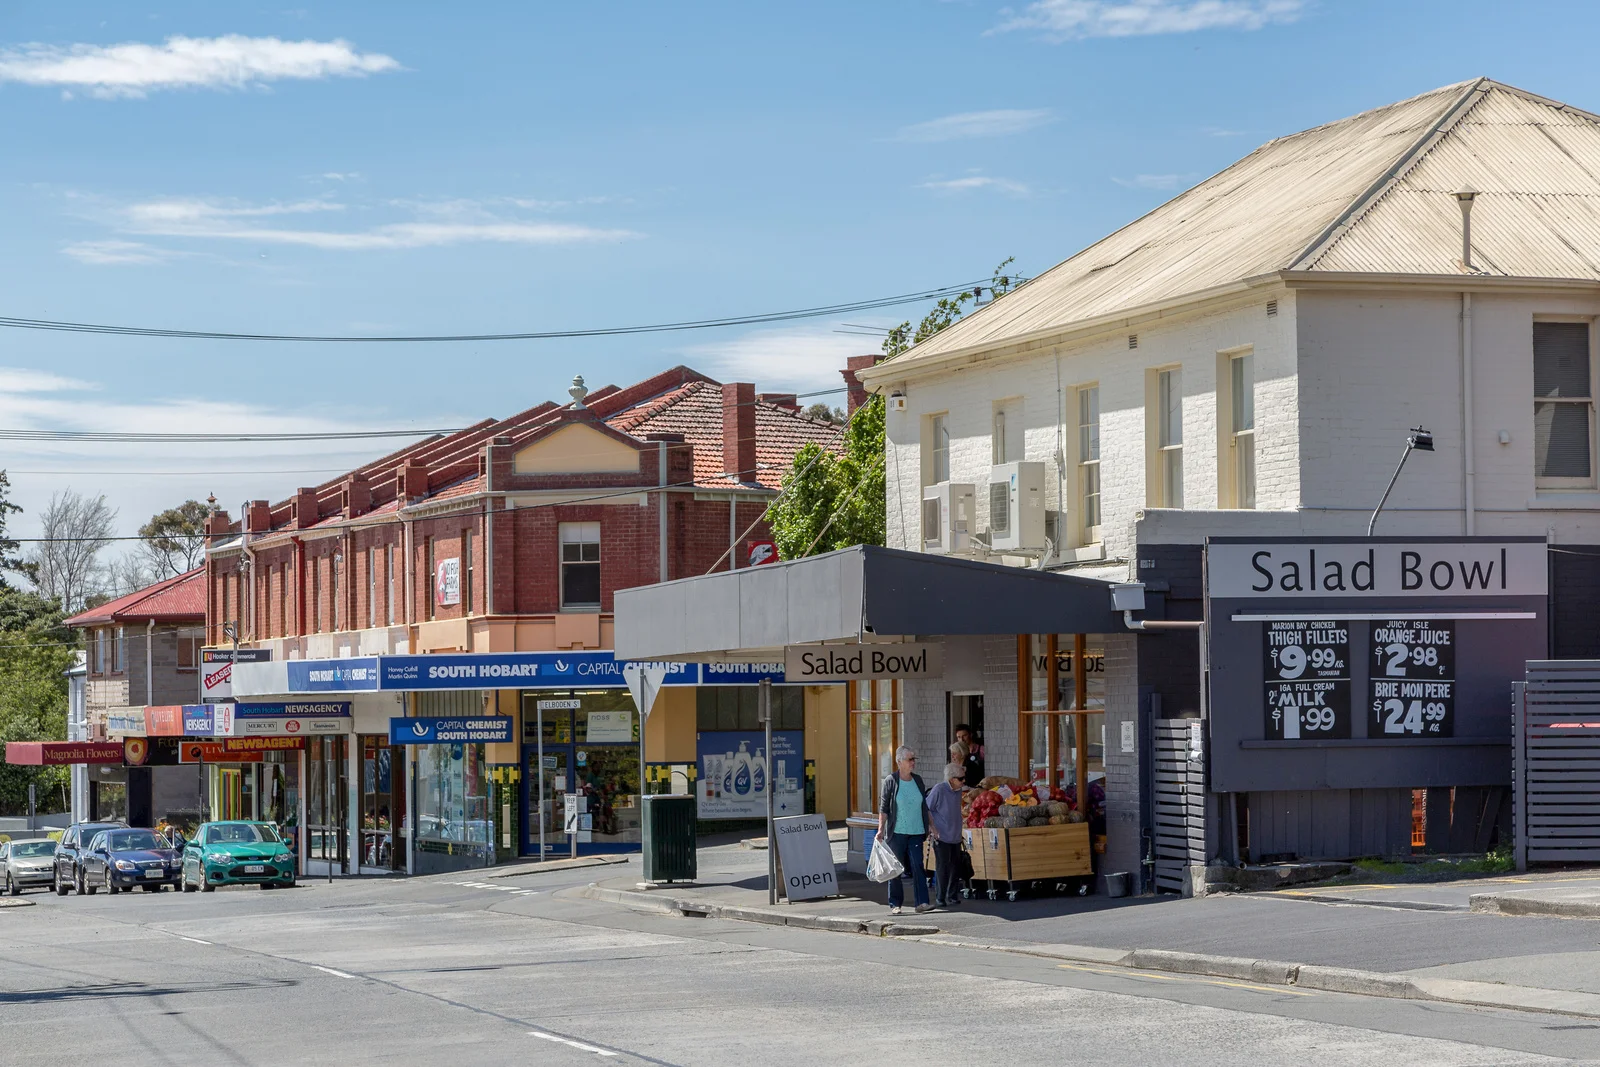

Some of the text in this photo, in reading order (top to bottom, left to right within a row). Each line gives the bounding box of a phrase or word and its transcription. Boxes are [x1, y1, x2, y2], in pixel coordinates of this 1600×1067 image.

[1251, 548, 1507, 591] Salad Bowl
[1272, 621, 1336, 630] MARION BAY CHICKEN
[1413, 621, 1429, 629] ISLE
[1268, 629, 1347, 645] THIGH FILLETS
[1375, 628, 1450, 645] ORANGE JUICE
[709, 663, 785, 673] SOUTH HOBA
[801, 649, 927, 675] Salad Bowl
[429, 665, 476, 678] SOUTH
[479, 664, 538, 677] HOBART
[577, 662, 620, 676] CAPITAL
[1295, 683, 1312, 691] FULL
[1313, 682, 1335, 690] CREAM
[1375, 682, 1450, 698] BRIE MON PERE
[1278, 691, 1326, 707] MILK
[285, 704, 343, 713] NEWSAGENCY
[436, 720, 508, 730] CAPITAL CHEMIST
[437, 731, 507, 740] SOUTH HOBART
[227, 737, 301, 750] NEWSAGENT
[44, 748, 119, 761] Magnolia Flowers
[780, 822, 823, 835] Salad Bowl
[790, 871, 833, 890] open
